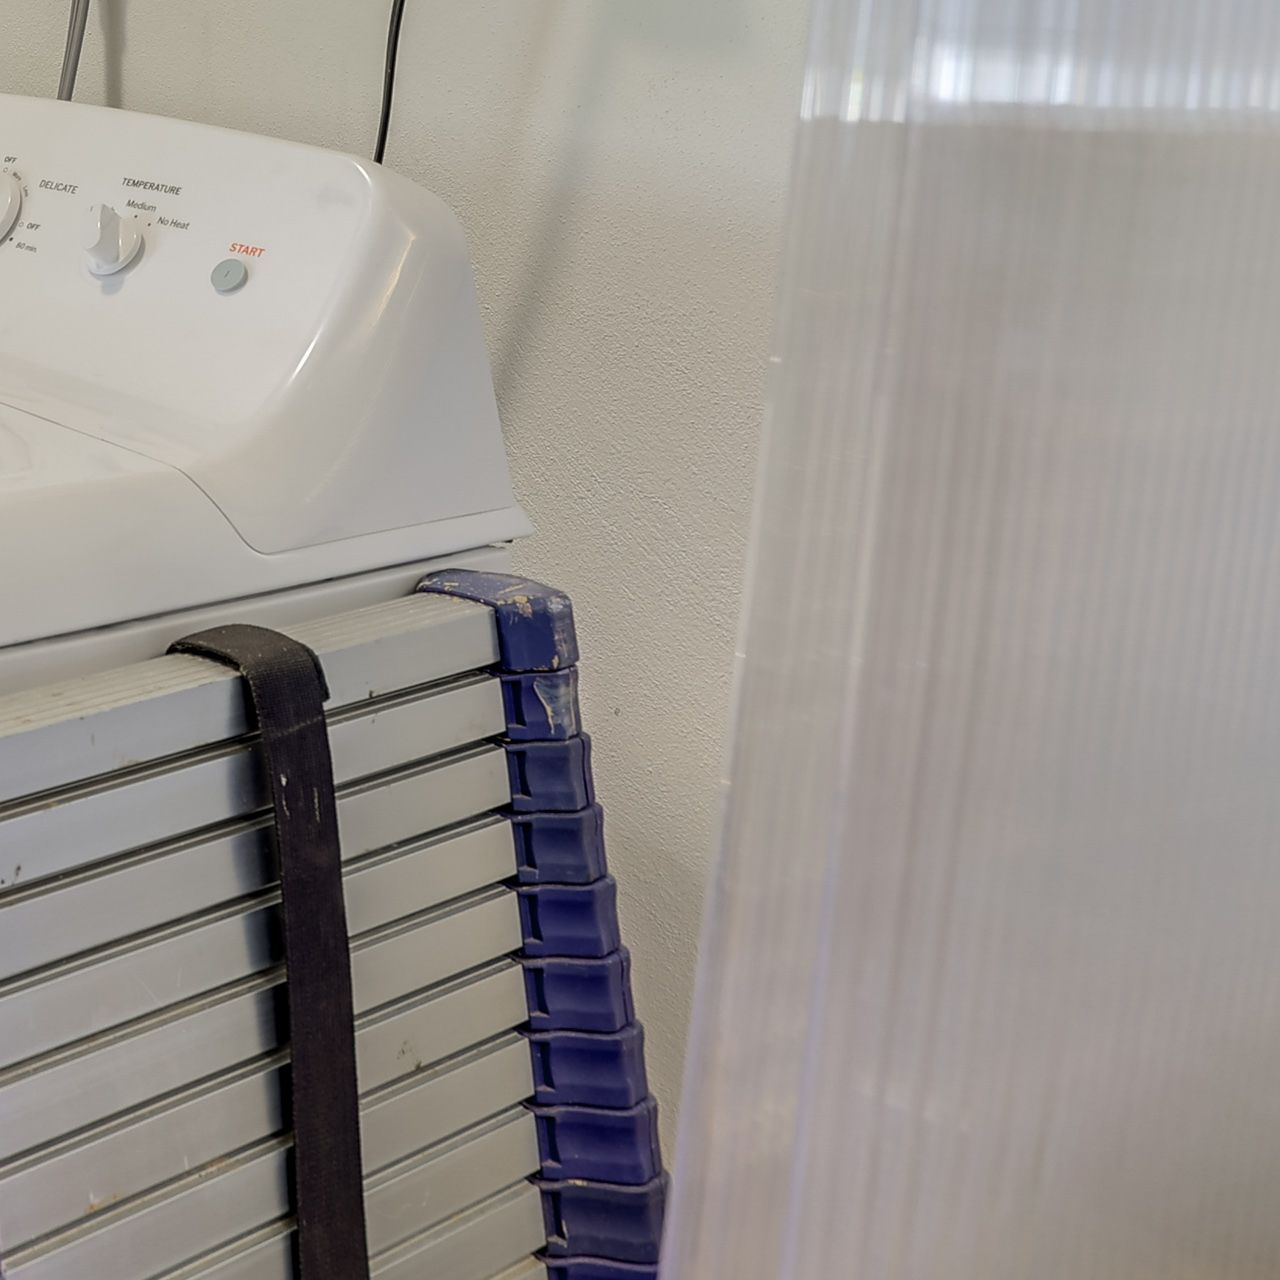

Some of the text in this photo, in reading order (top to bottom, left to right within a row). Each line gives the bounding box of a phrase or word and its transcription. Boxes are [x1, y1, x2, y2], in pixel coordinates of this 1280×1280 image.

[4, 156, 17, 164] OFF
[39, 179, 79, 195] DELICATE
[122, 177, 182, 196] TEMPERATURE
[126, 199, 157, 212] Medium
[26, 223, 40, 231] OFF
[157, 216, 190, 230] No Heat
[229, 243, 265, 258] START
